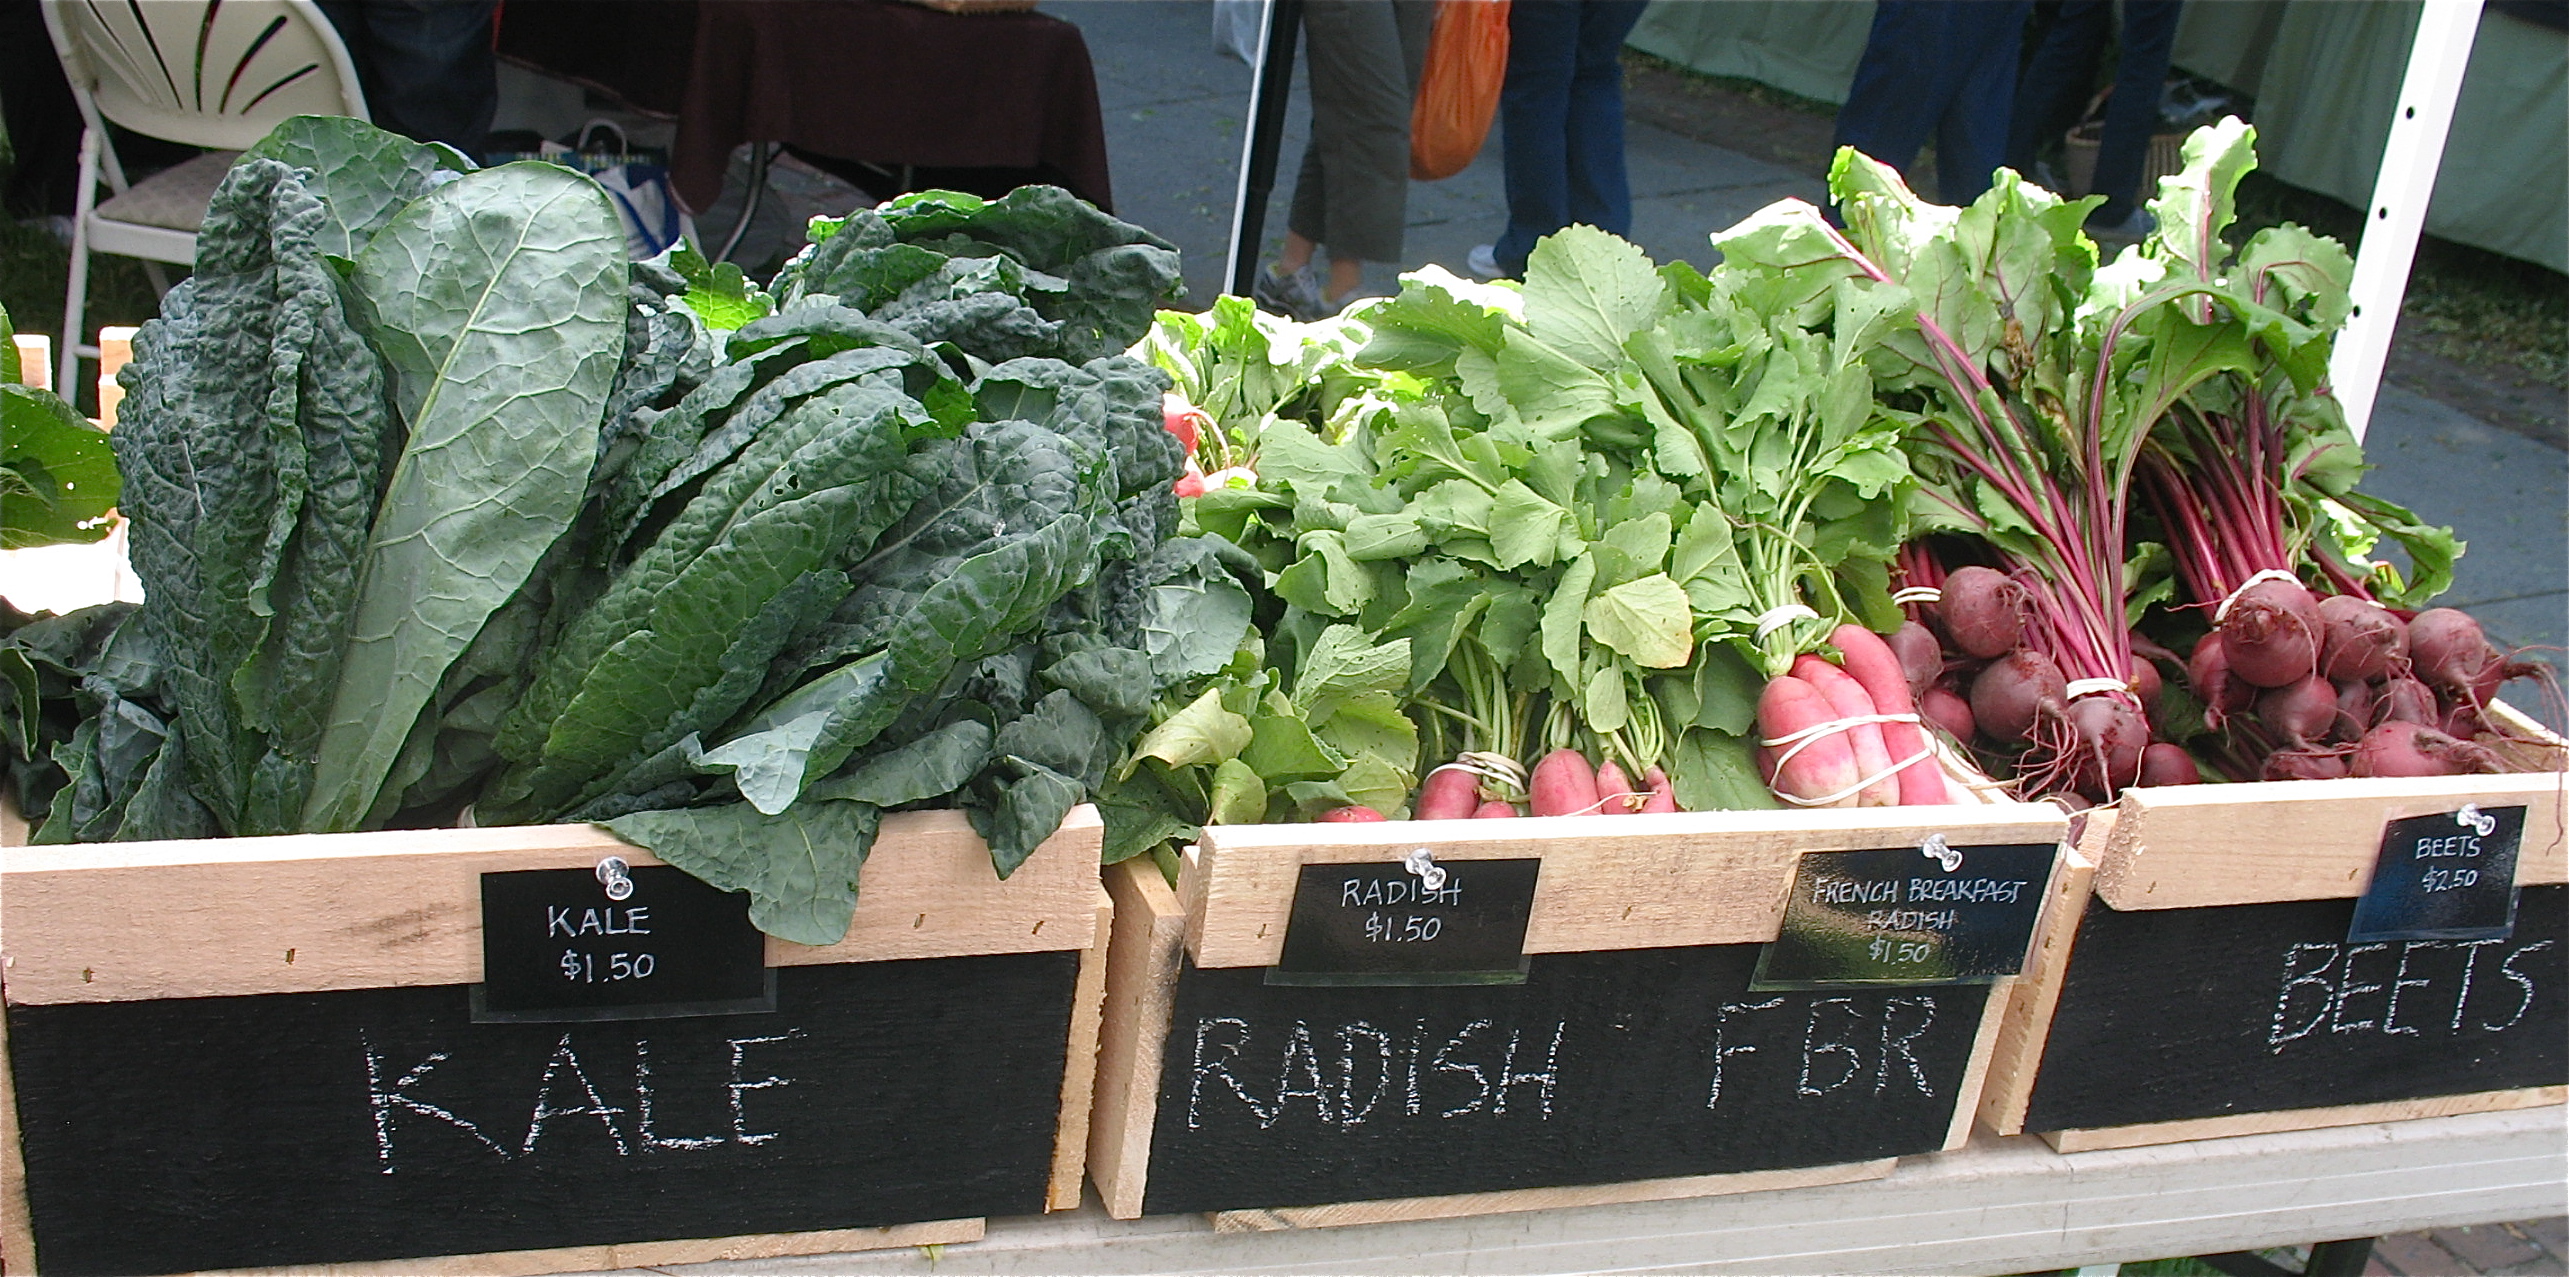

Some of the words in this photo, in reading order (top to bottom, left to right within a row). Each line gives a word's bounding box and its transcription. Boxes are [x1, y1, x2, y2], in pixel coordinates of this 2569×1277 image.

[2415, 836, 2481, 860] BEETS
[1341, 877, 1462, 907] RADISH
[1812, 878, 1898, 904] FRENCH
[1908, 878, 2028, 904] BREAKFAST
[2421, 865, 2478, 893] $2.50
[547, 905, 651, 938] KALE
[1365, 911, 1442, 942] $1.50
[1868, 908, 1955, 931] RADISH
[1868, 936, 1931, 965] $1.50
[559, 948, 655, 984] $1.50
[2268, 938, 2554, 1055] BEETS
[1187, 1017, 1566, 1132] RADISH
[358, 1026, 808, 1176] KALE
